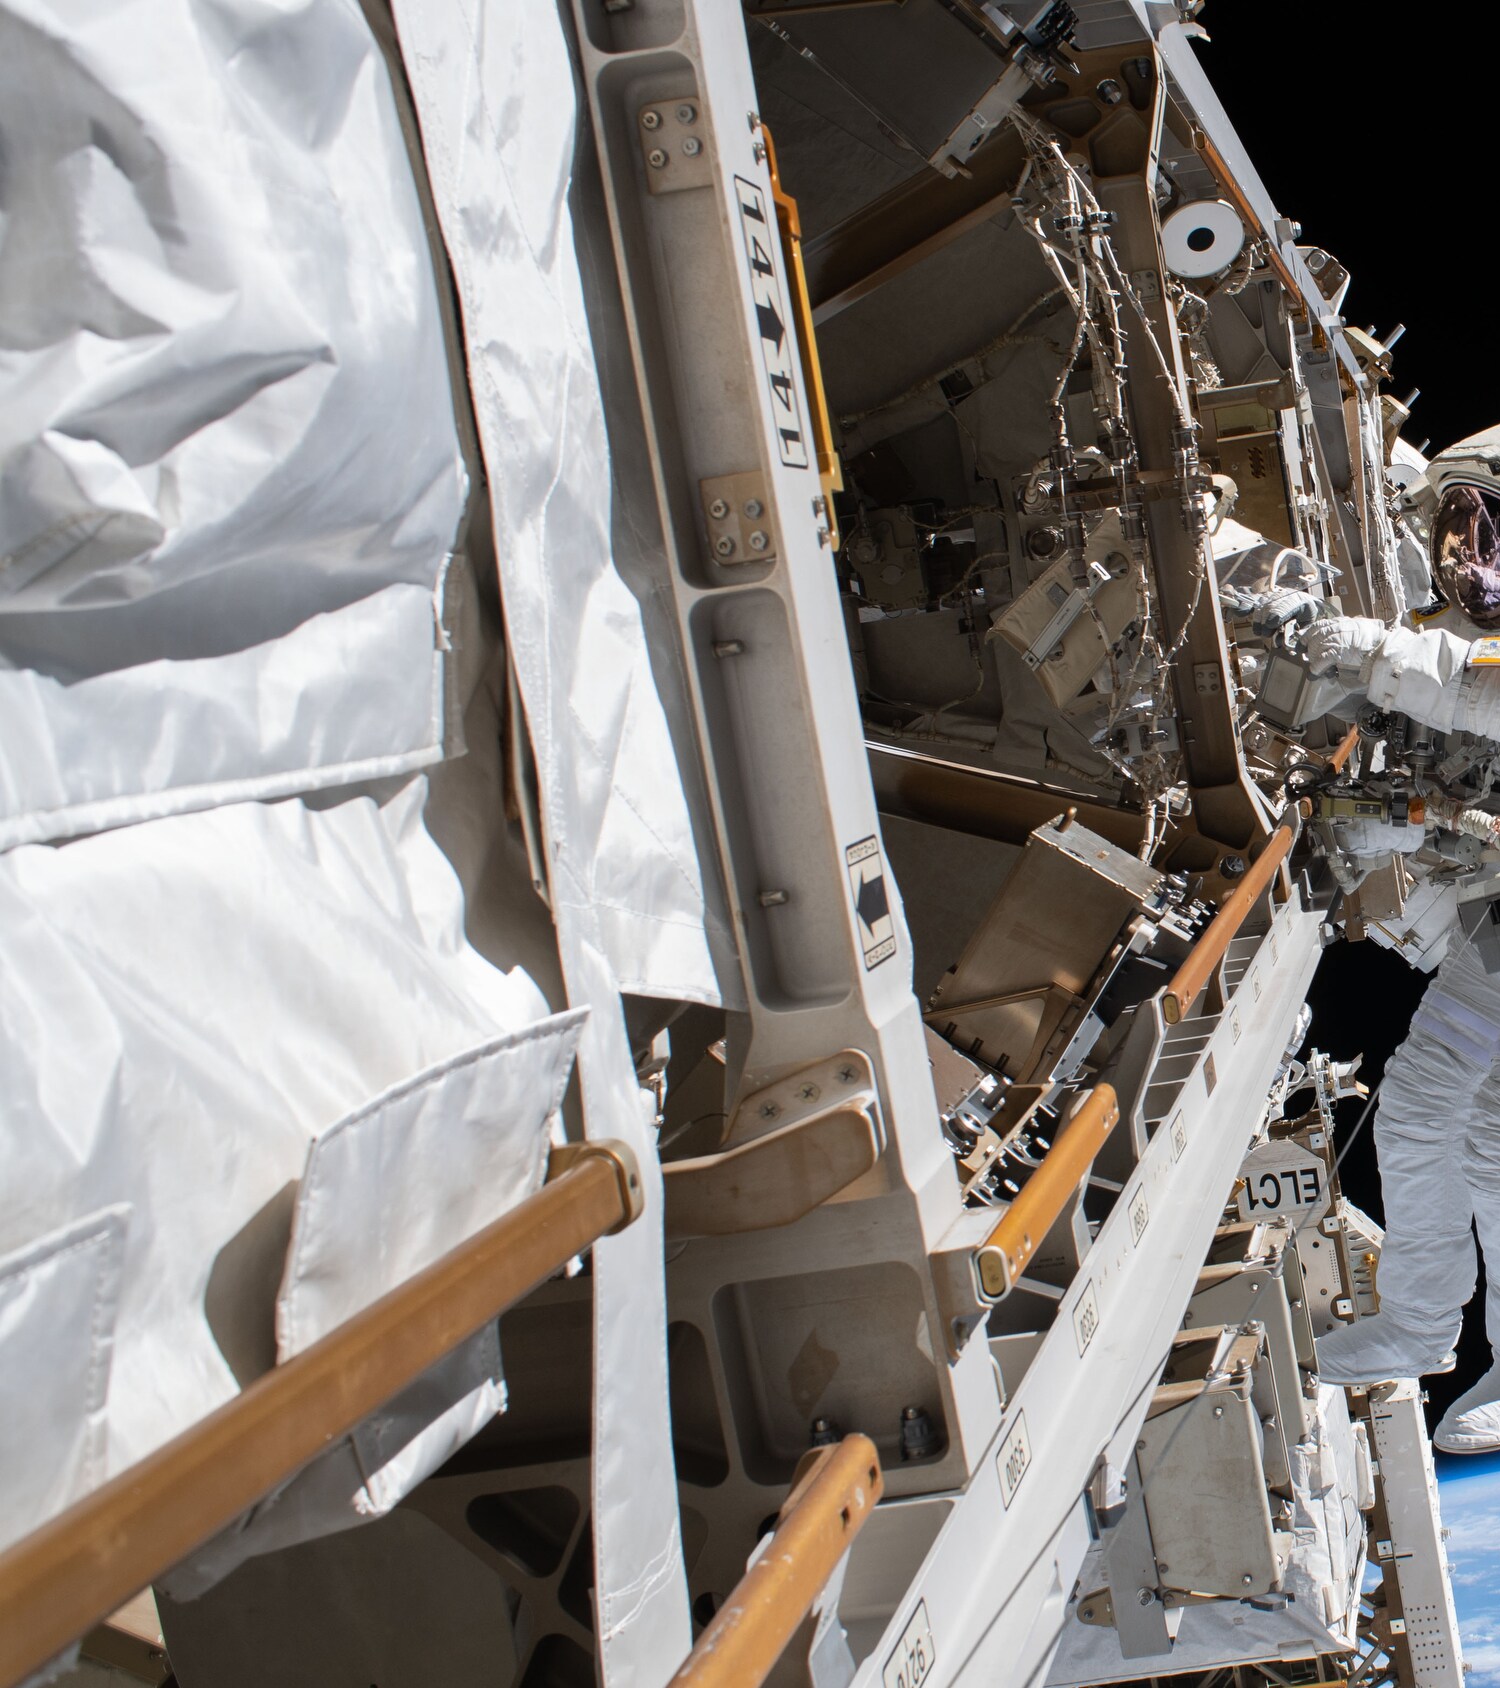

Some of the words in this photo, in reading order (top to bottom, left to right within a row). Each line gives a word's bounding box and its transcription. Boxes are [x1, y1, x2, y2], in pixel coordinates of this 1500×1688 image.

[742, 195, 774, 278] 14
[770, 370, 801, 455] 14
[1245, 1168, 1321, 1210] ELC1
[1080, 1303, 1095, 1344] 9330
[1006, 1438, 1025, 1491] 9300
